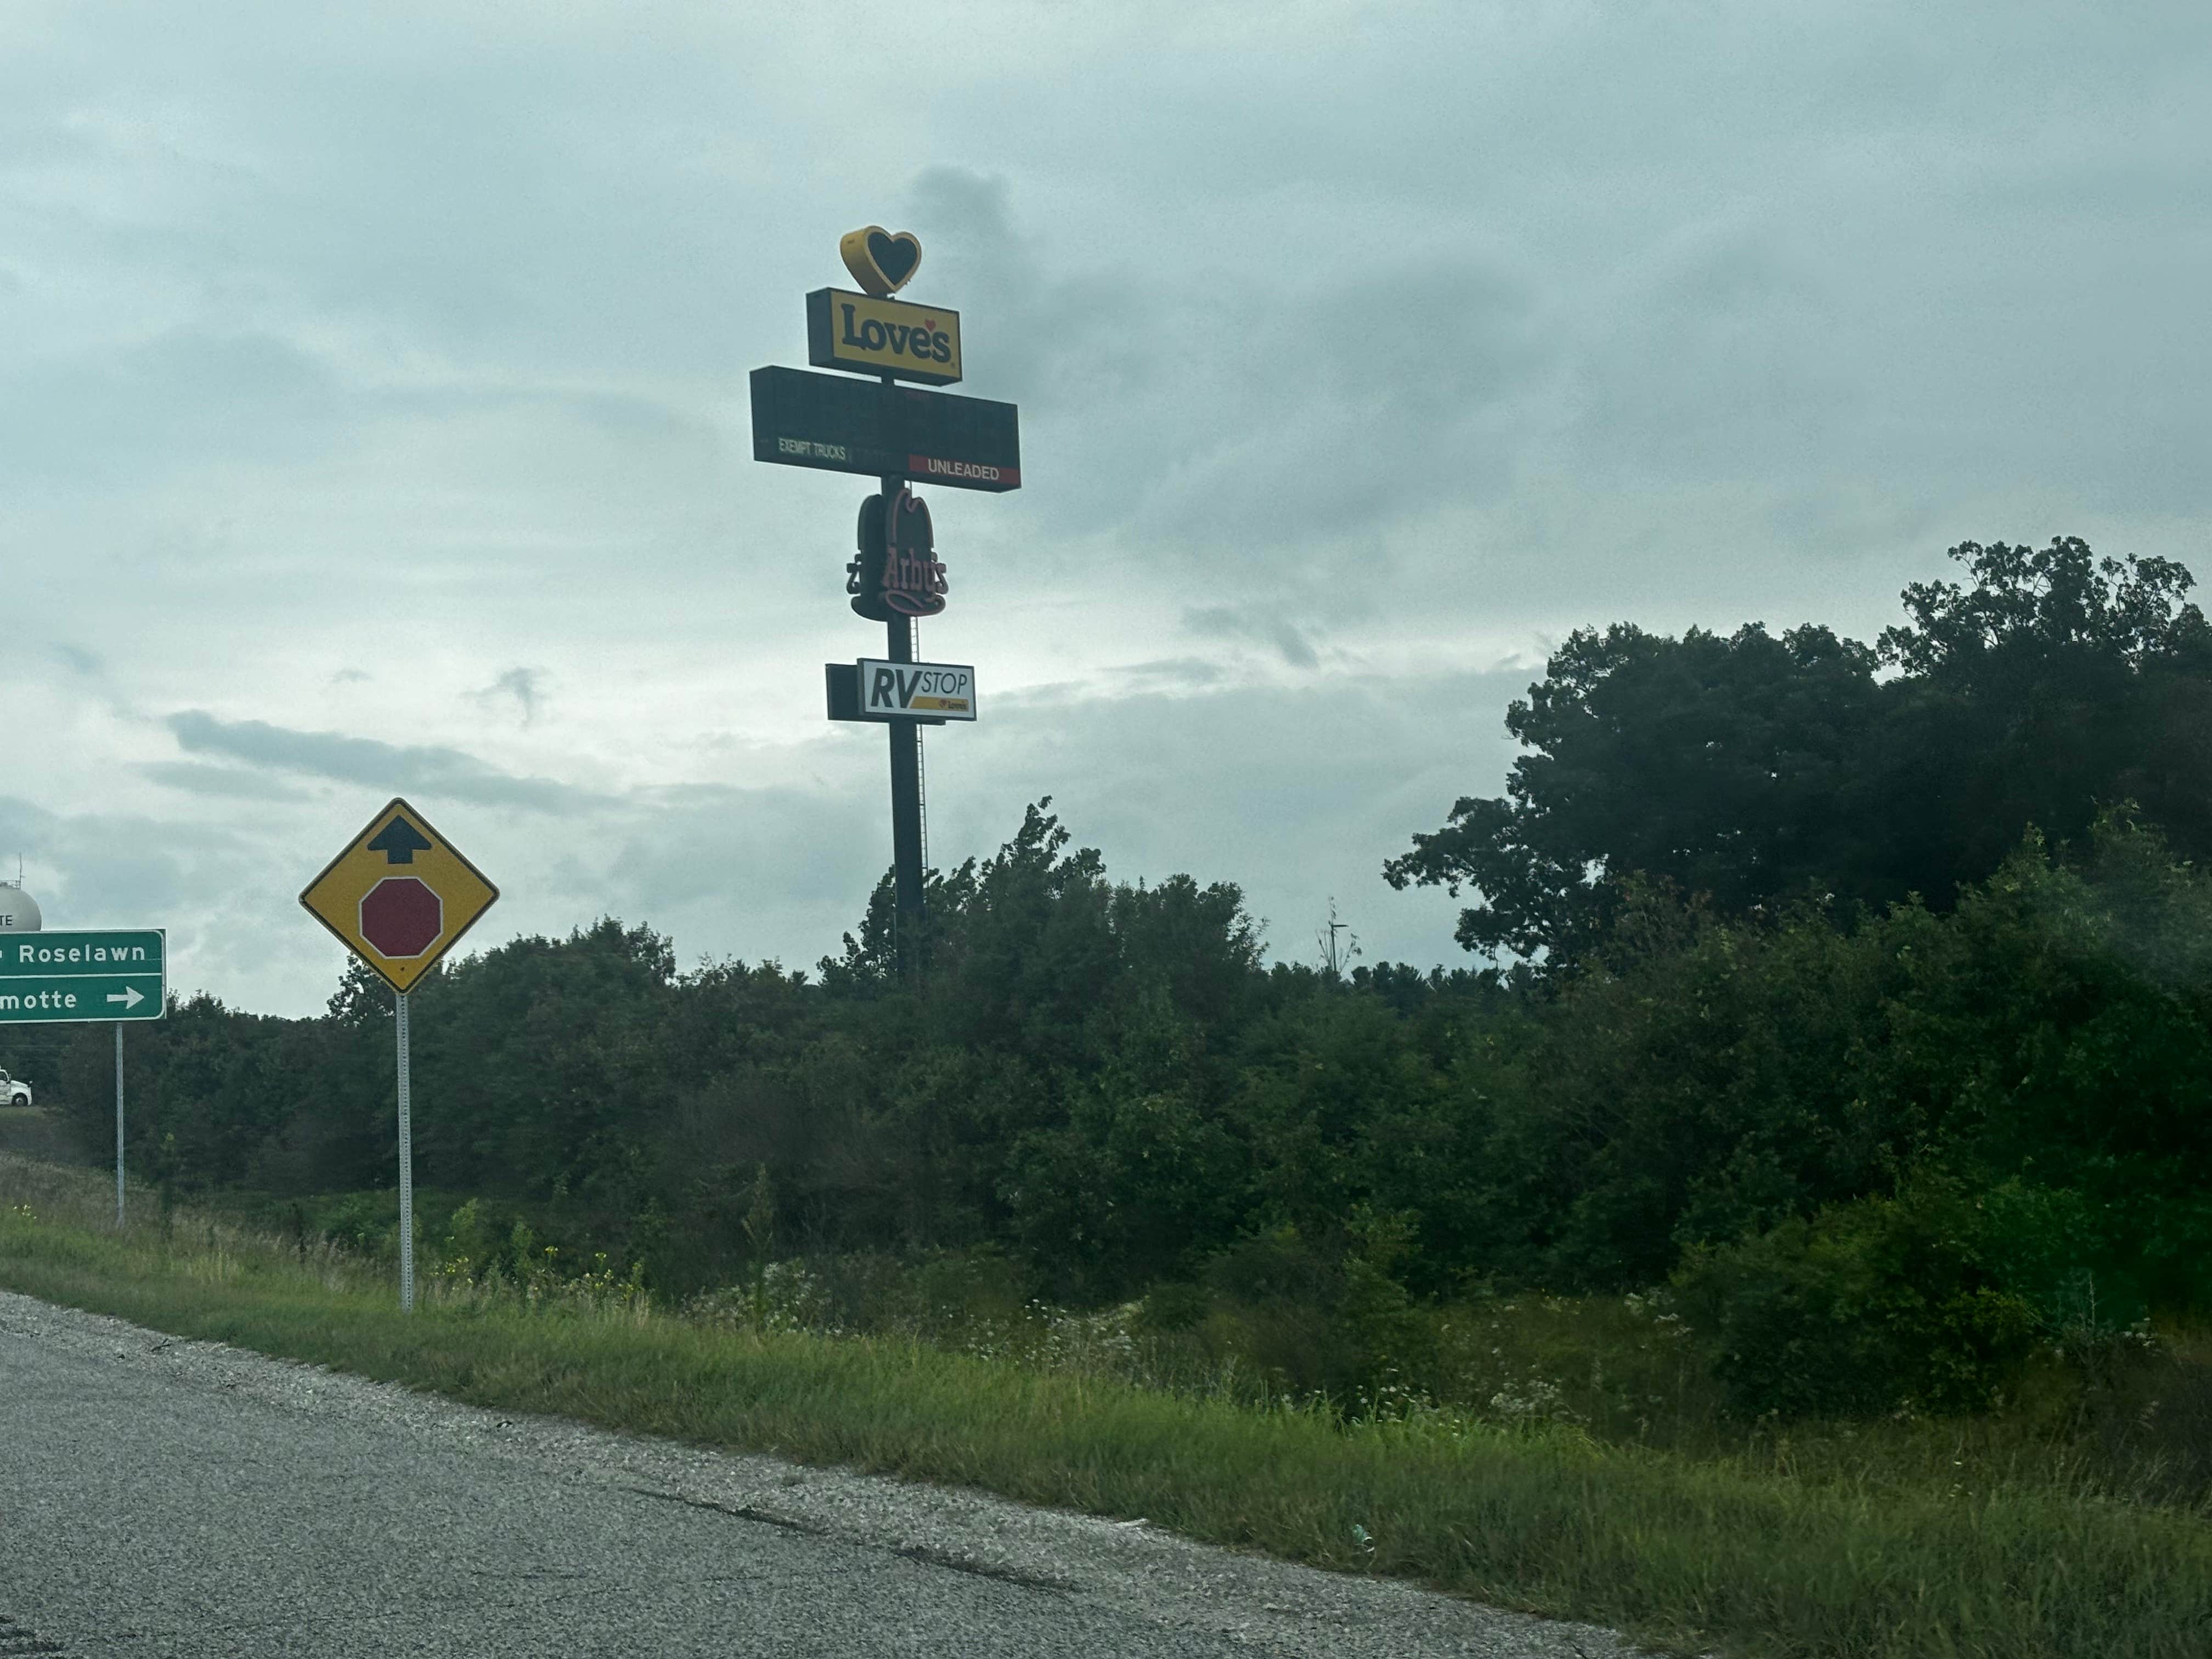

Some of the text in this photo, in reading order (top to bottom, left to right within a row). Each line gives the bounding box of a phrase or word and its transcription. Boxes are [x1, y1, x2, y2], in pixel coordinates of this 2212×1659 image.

[778, 437, 845, 461] EXEMPT TRUCKS
[928, 458, 1000, 481] UNLEADED
[871, 668, 967, 708] RV STOP
[19, 944, 145, 963] Roselawn
[0, 991, 77, 1009] motte
